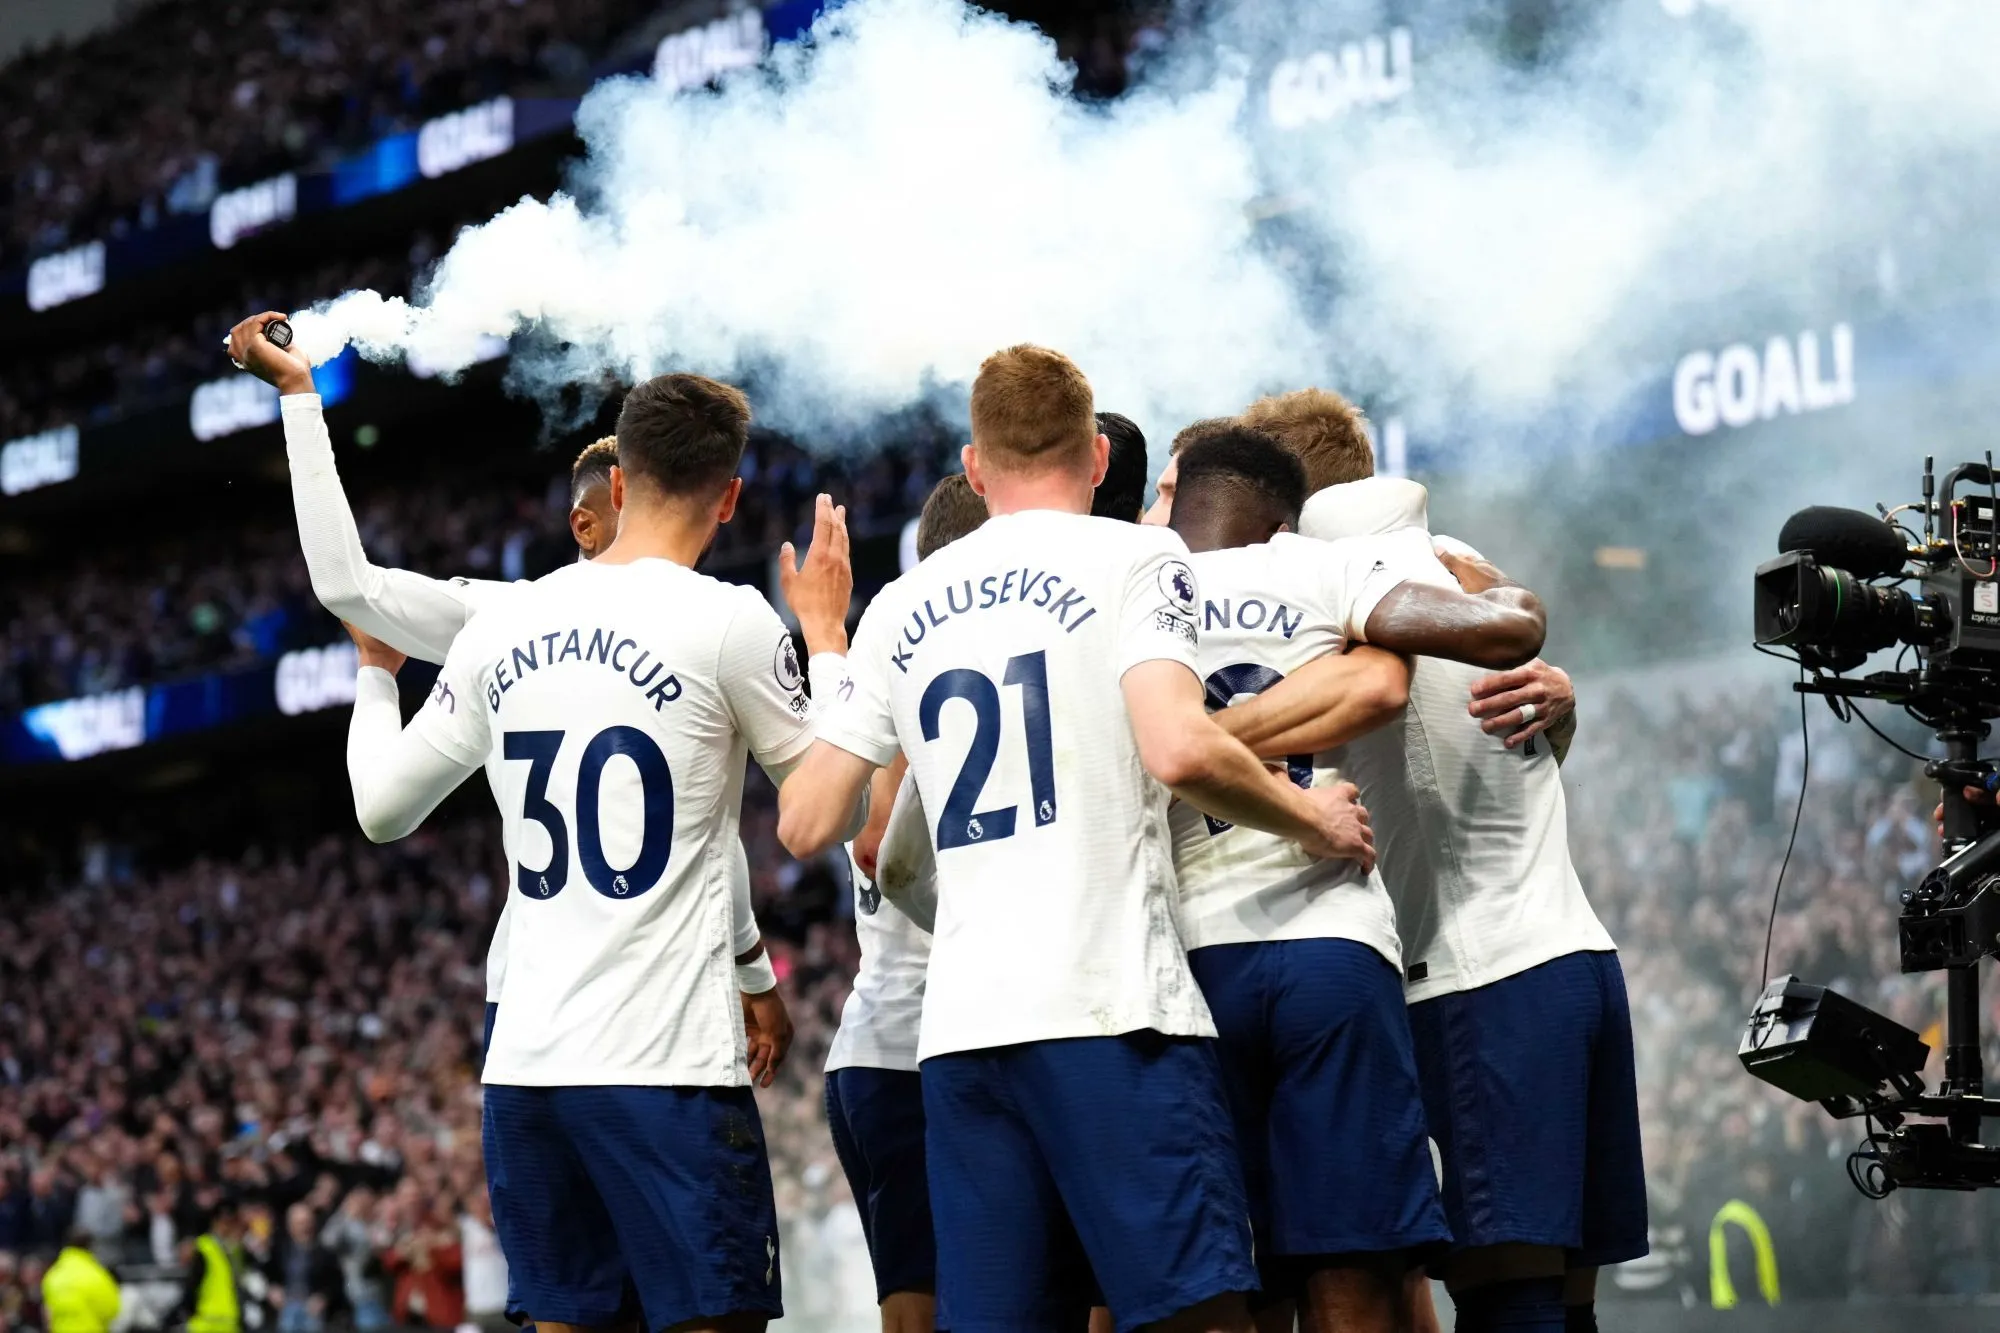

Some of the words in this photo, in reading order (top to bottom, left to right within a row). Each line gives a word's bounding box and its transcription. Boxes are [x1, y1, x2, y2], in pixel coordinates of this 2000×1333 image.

[1673, 322, 1855, 435] GOAL!
[487, 627, 683, 714] BENTANCUR
[891, 568, 1096, 674] KULUSEVSKI
[1203, 598, 1304, 640] NON
[919, 649, 1056, 852] 21
[503, 725, 674, 900] 30
